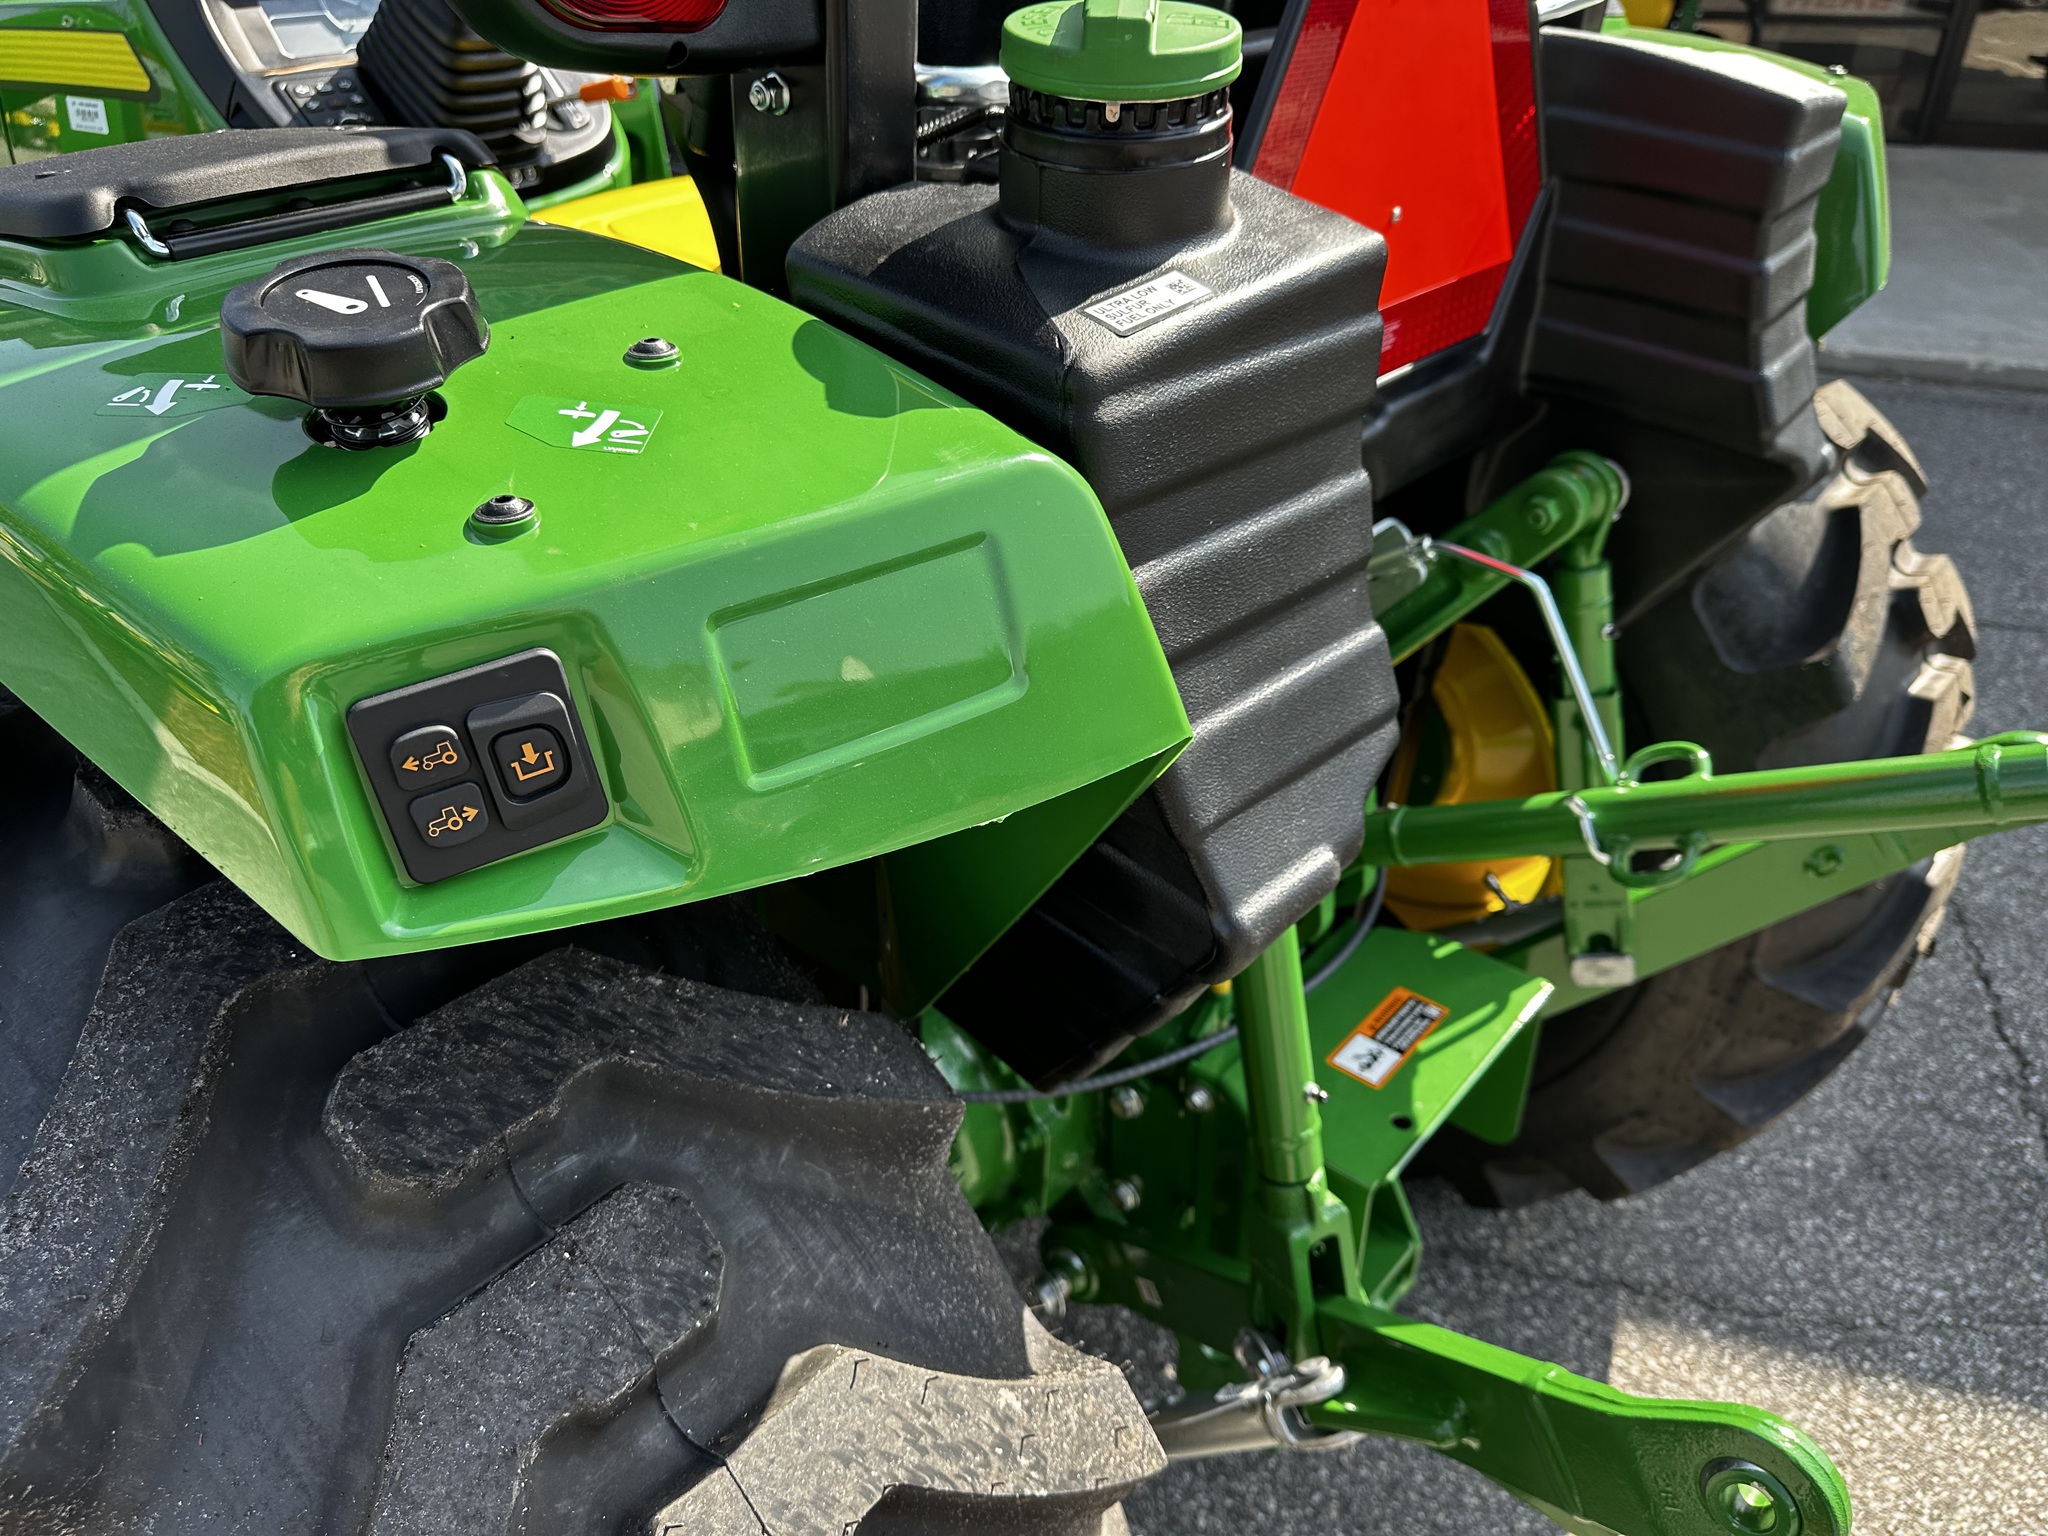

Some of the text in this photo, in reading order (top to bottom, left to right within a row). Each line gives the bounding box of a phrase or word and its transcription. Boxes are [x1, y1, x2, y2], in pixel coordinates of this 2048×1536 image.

[1093, 285, 1158, 315] ULTRA LOW
[1105, 299, 1151, 320] SULFUR
[1115, 298, 1175, 327] FUEL ONLY
